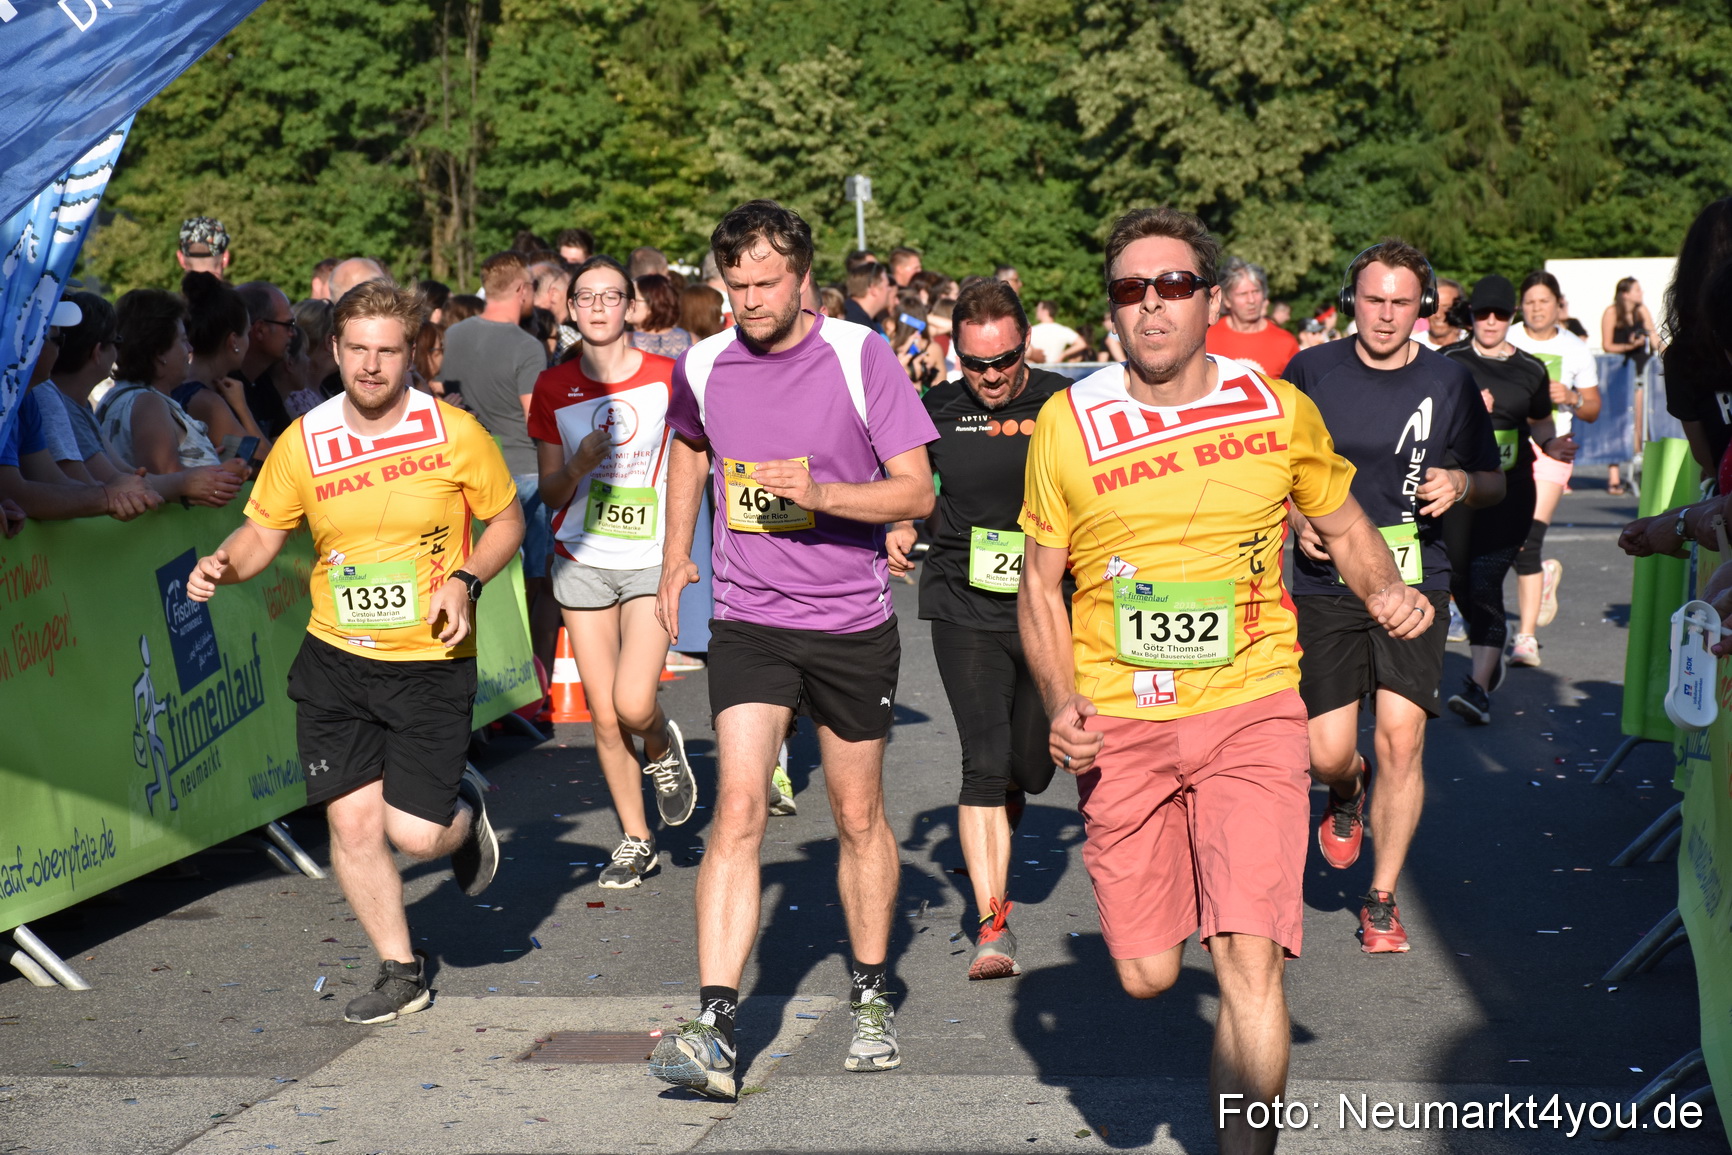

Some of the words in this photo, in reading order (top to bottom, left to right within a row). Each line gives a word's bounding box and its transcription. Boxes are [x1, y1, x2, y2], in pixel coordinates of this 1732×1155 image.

[1092, 451, 1184, 496] MAX
[1193, 431, 1288, 467] BÖGL
[315, 471, 374, 502] MAX
[381, 453, 451, 482] BÖGL
[595, 501, 646, 525] 1561
[743, 512, 770, 520] Günther
[986, 574, 1008, 582] Richter
[342, 585, 406, 610] 1333
[1128, 592, 1169, 602] firmenlauf
[11, 591, 76, 678] länger!
[1129, 610, 1219, 643] 1332
[1143, 643, 1165, 652] Götz
[1167, 644, 1205, 652] Thomas
[1144, 652, 1159, 660] Bögl
[165, 632, 265, 766] firmenlauf
[180, 745, 222, 798] neumarkt
